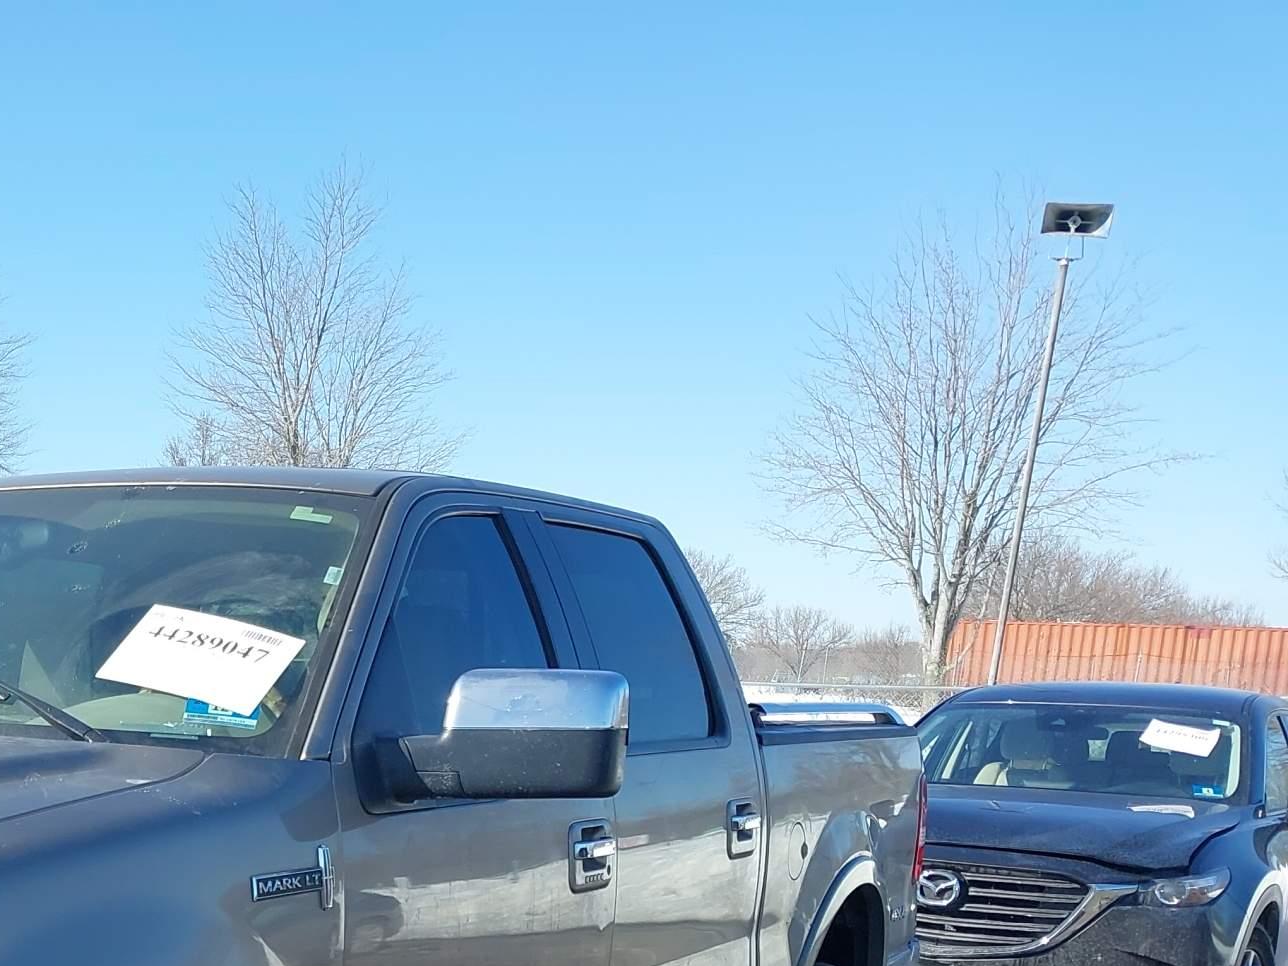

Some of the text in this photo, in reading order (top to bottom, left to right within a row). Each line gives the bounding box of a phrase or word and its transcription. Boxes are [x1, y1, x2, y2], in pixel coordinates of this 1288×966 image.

[149, 626, 270, 663] 44289047
[258, 873, 321, 894] MARK LT
